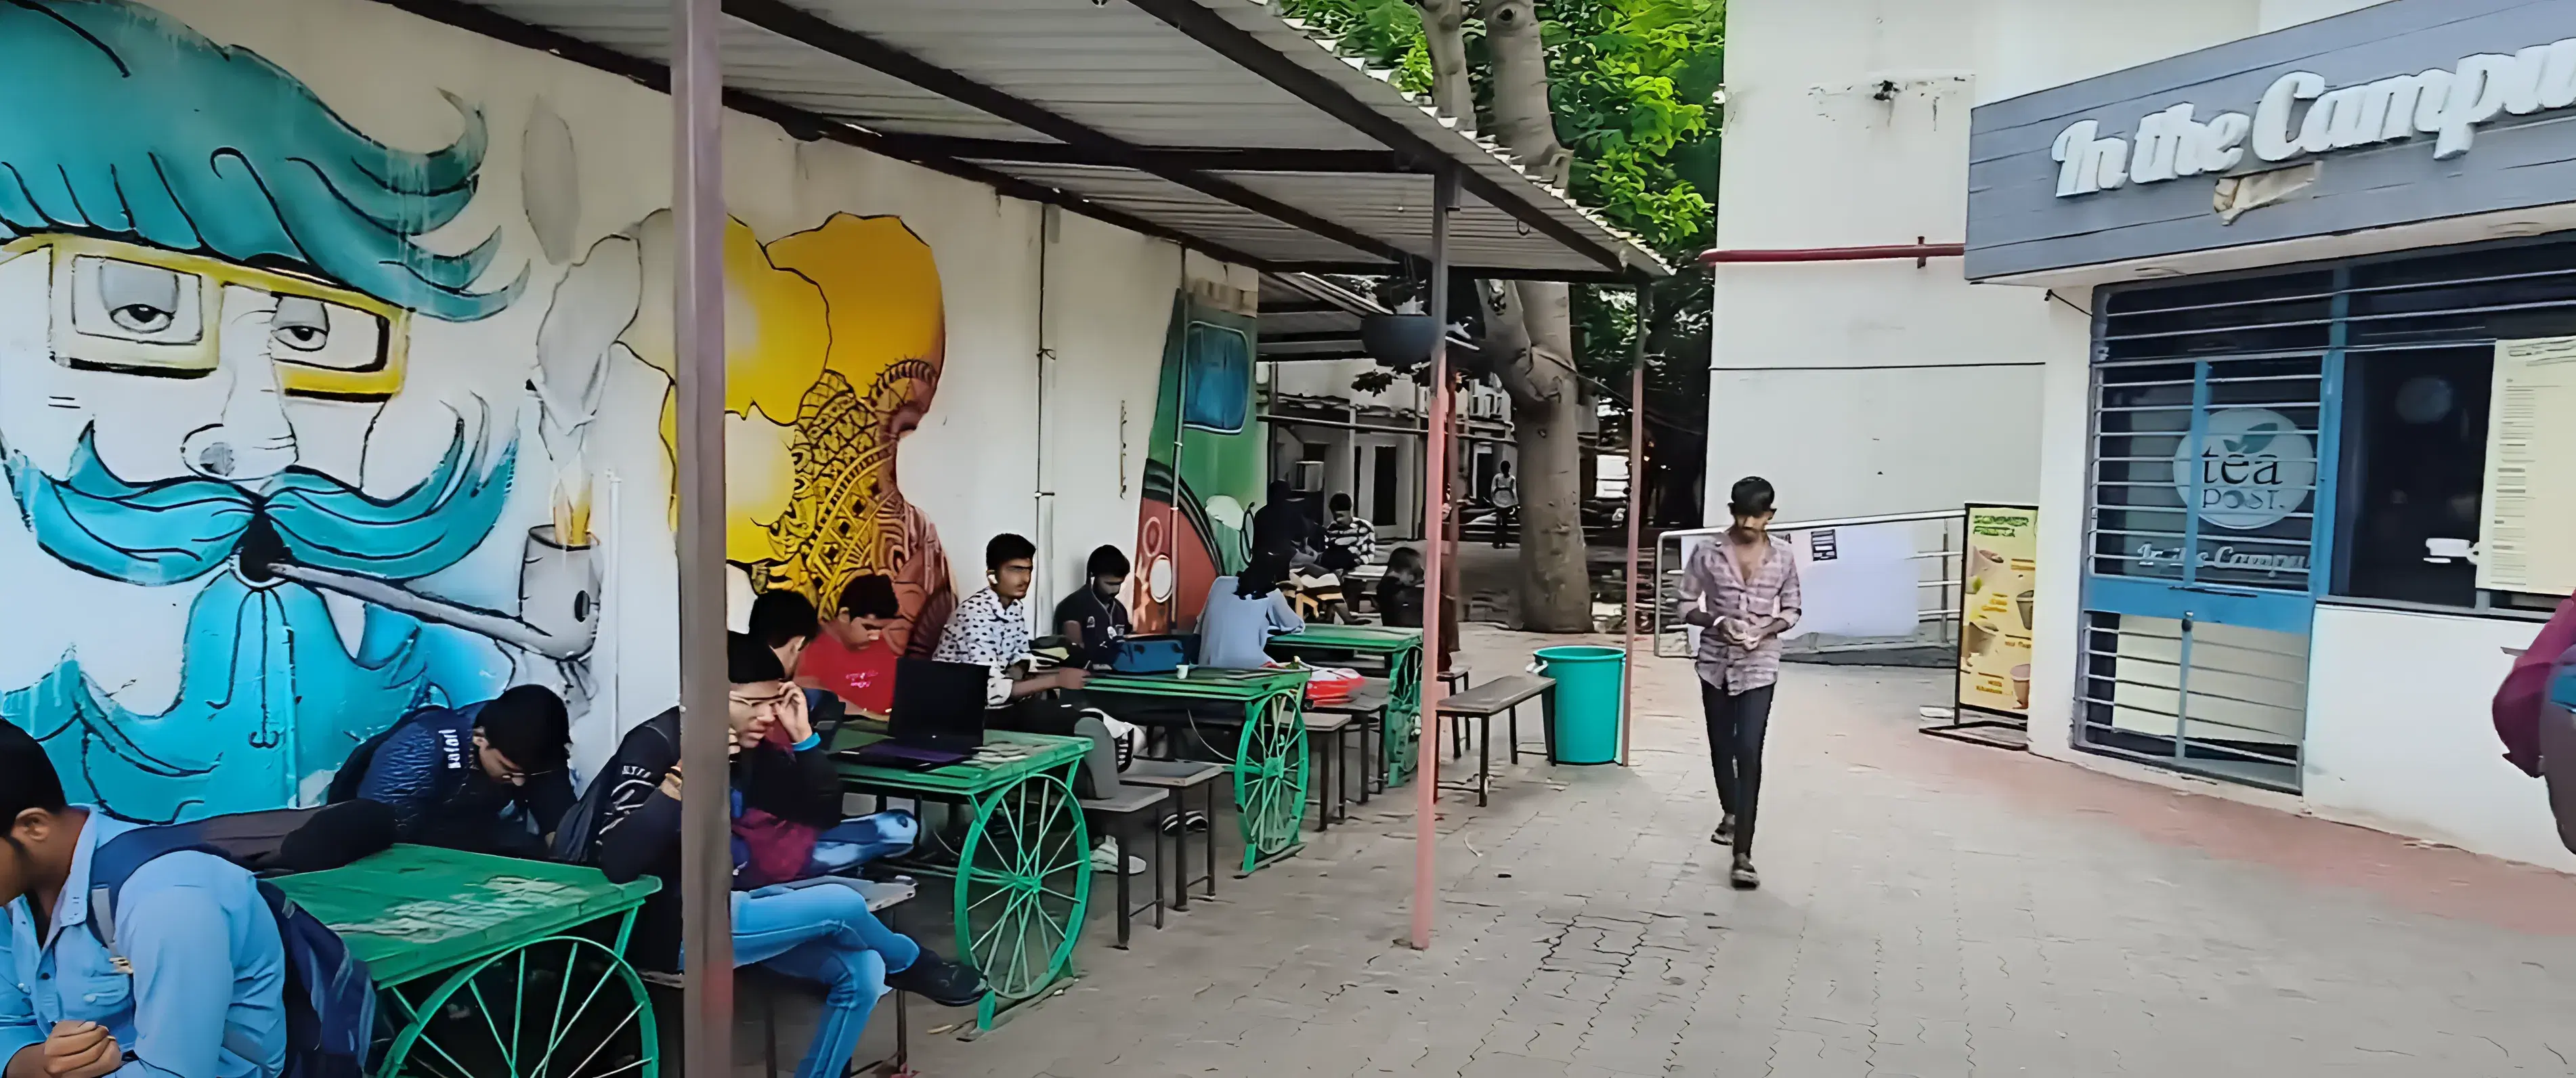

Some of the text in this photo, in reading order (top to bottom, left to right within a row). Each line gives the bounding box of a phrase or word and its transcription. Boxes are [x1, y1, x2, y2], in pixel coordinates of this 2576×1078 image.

[2051, 118, 2128, 198] In
[2130, 101, 2250, 184] the
[2202, 445, 2283, 485] tea
